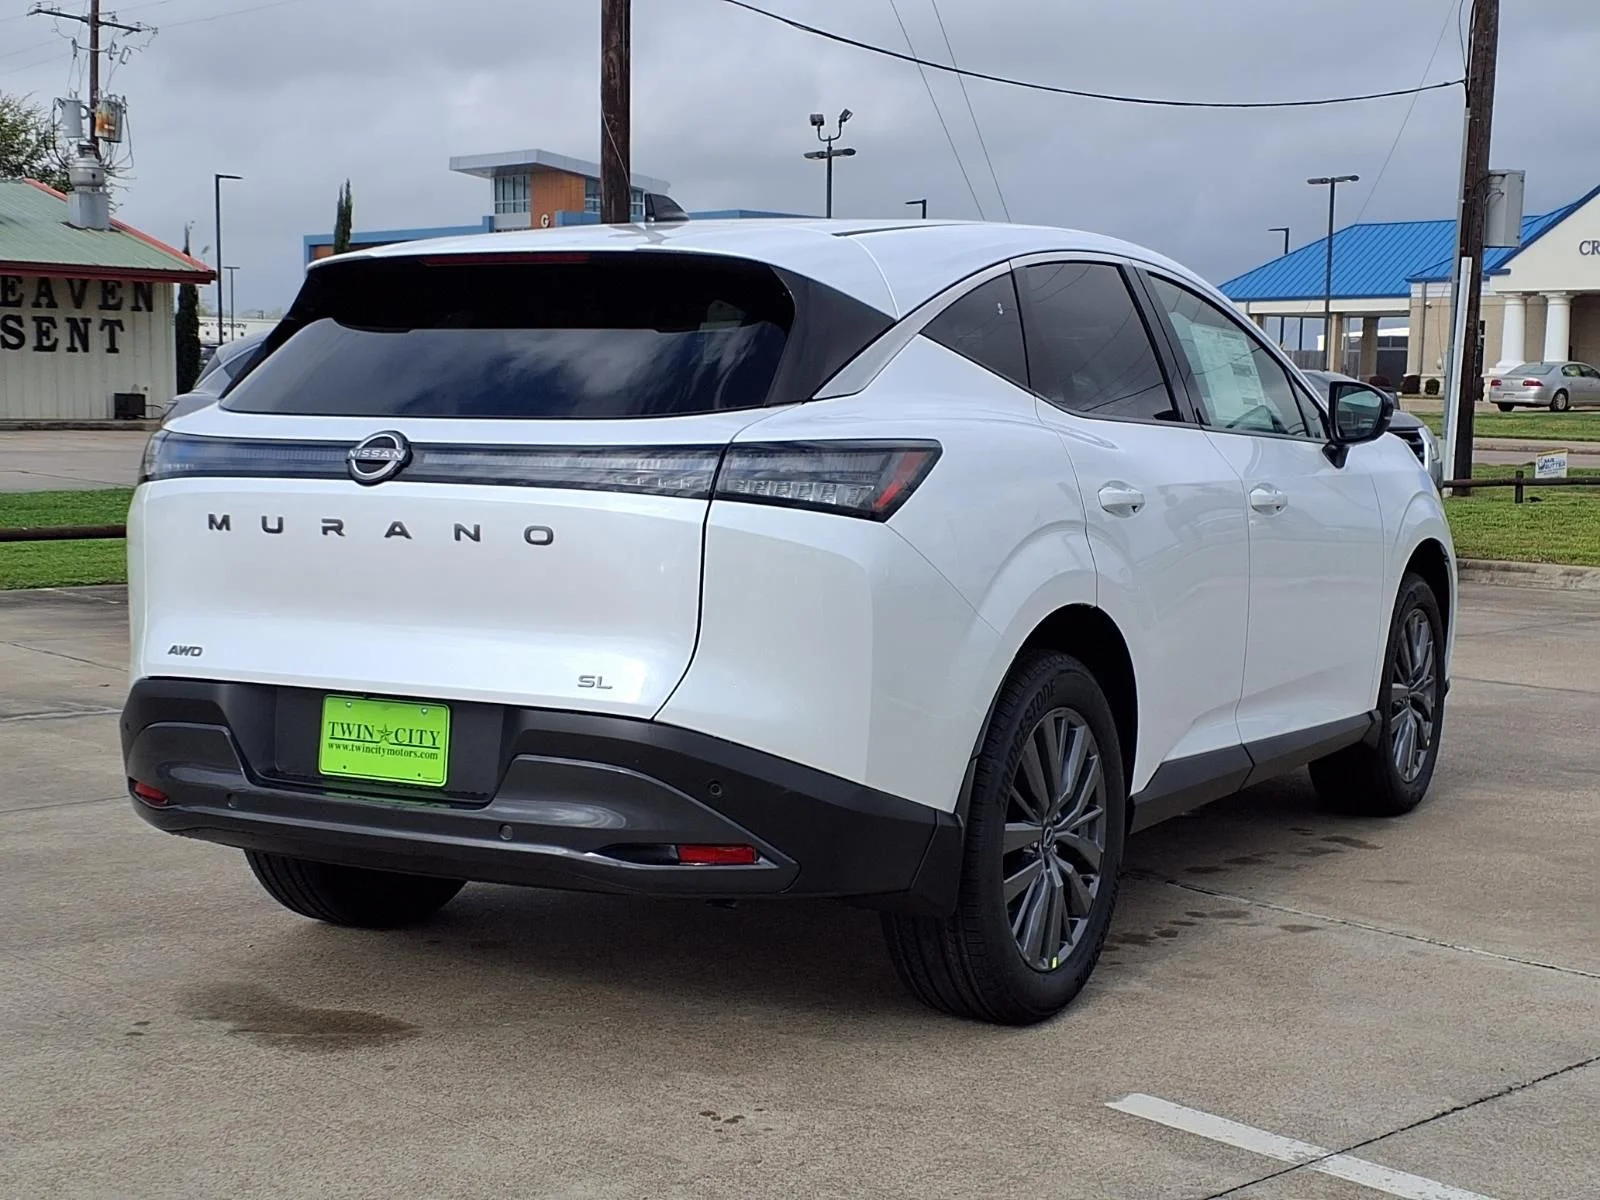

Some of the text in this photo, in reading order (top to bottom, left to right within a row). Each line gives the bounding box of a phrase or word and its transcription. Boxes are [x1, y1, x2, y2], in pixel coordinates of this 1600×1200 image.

[0, 275, 154, 312] EAVEN
[0, 314, 124, 353] SENT
[349, 448, 405, 460] NISSAN
[207, 513, 554, 546] MURANO
[167, 644, 203, 657] AWD
[577, 674, 613, 689] SL
[328, 721, 440, 746] TWIN CITY
[328, 742, 439, 761] www.twincitymotors.com
